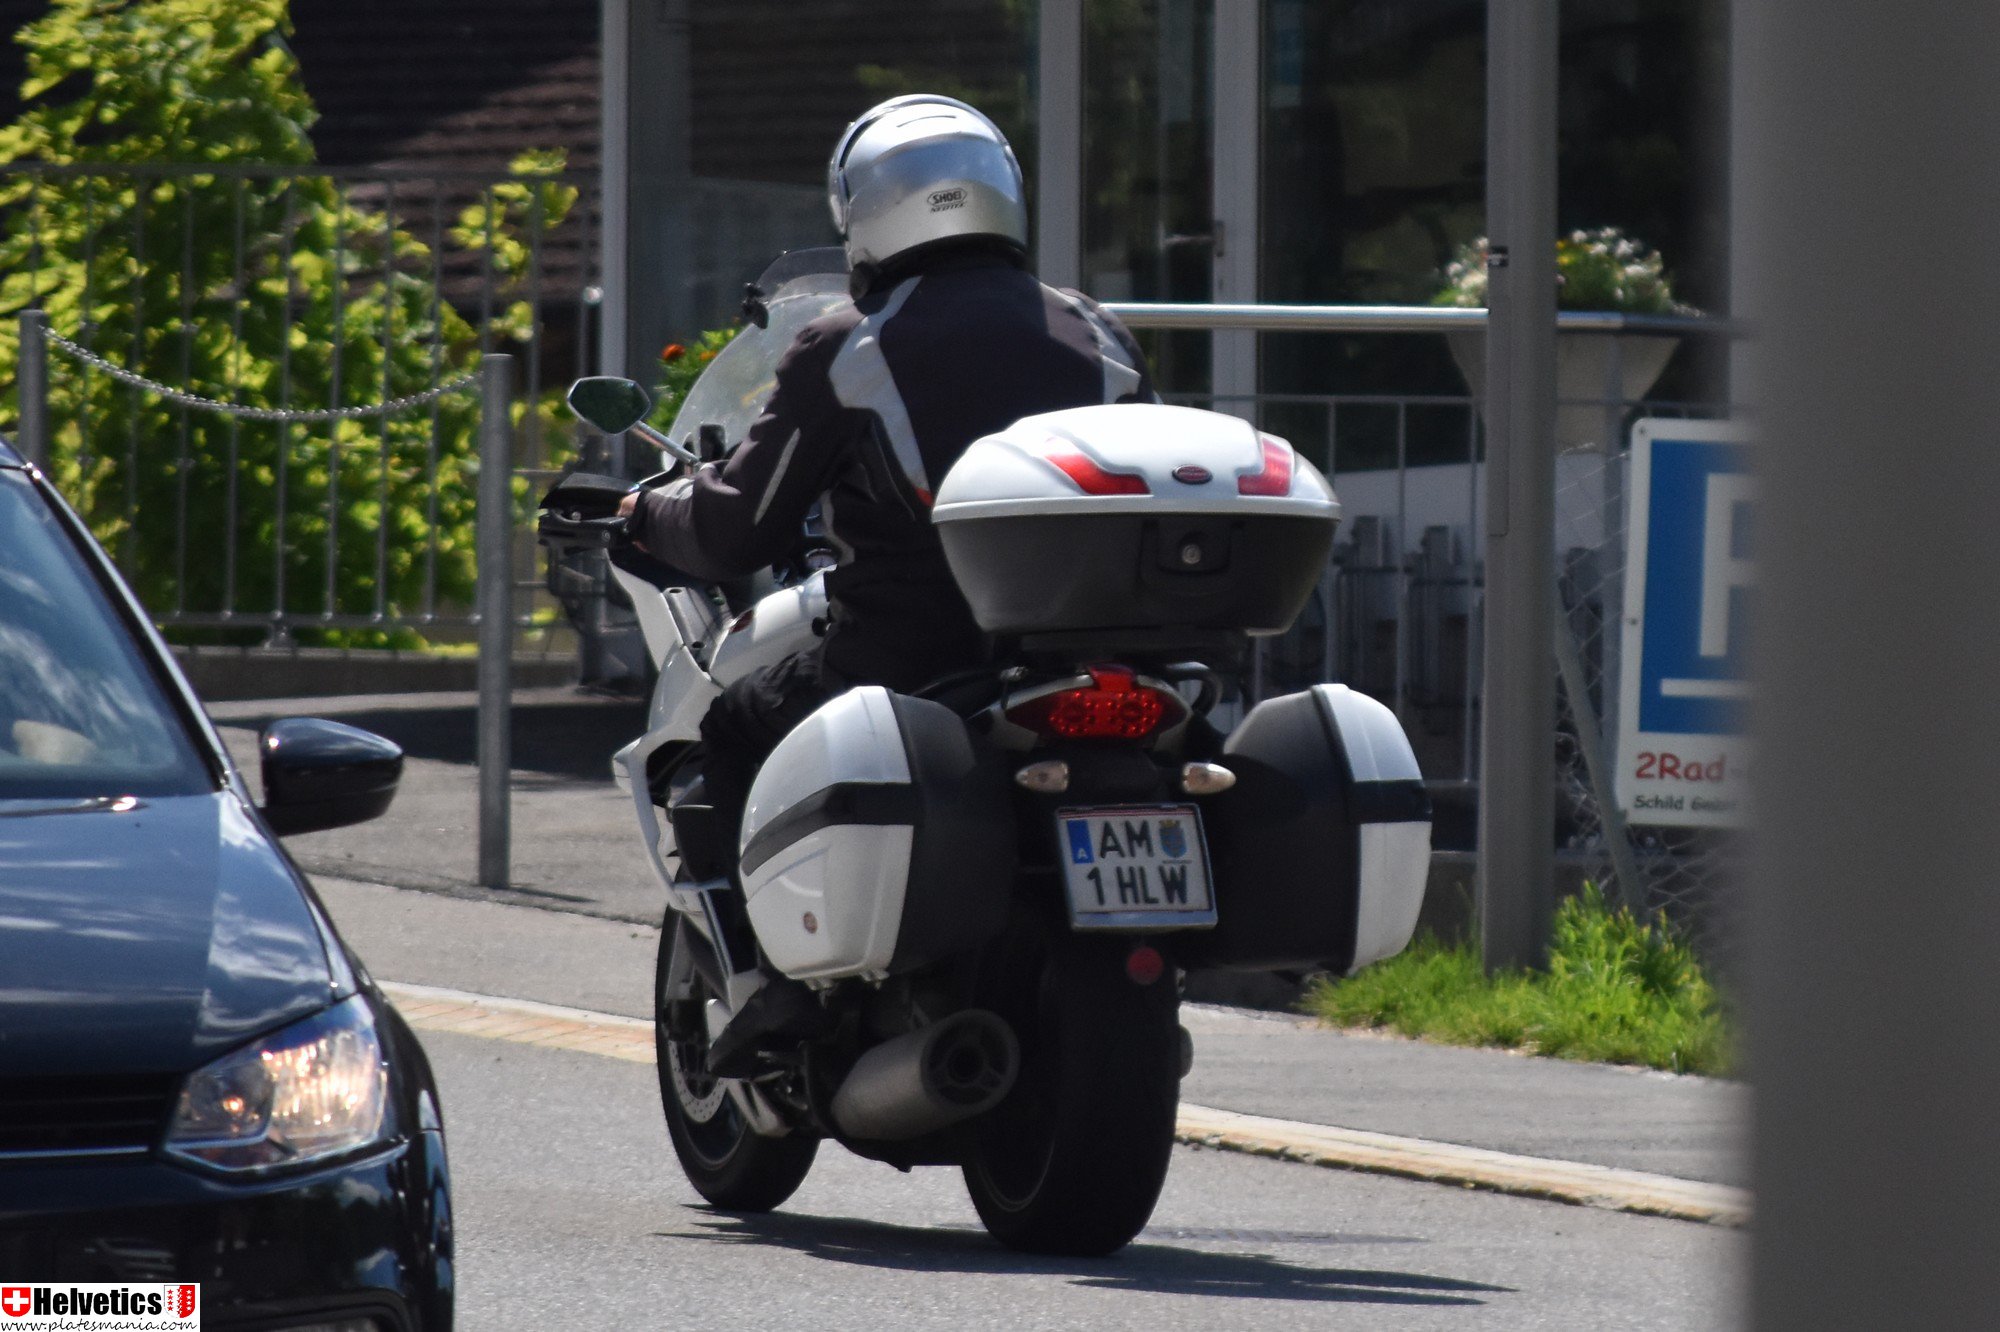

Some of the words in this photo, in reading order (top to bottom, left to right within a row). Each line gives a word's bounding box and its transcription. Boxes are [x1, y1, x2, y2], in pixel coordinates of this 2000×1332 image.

[1635, 751, 1727, 782] 2Rad
[1633, 794, 1684, 811] Schild
[1077, 848, 1089, 860] A
[1100, 820, 1155, 859] AM
[1087, 866, 1105, 906] 1
[1116, 865, 1188, 905] HLW
